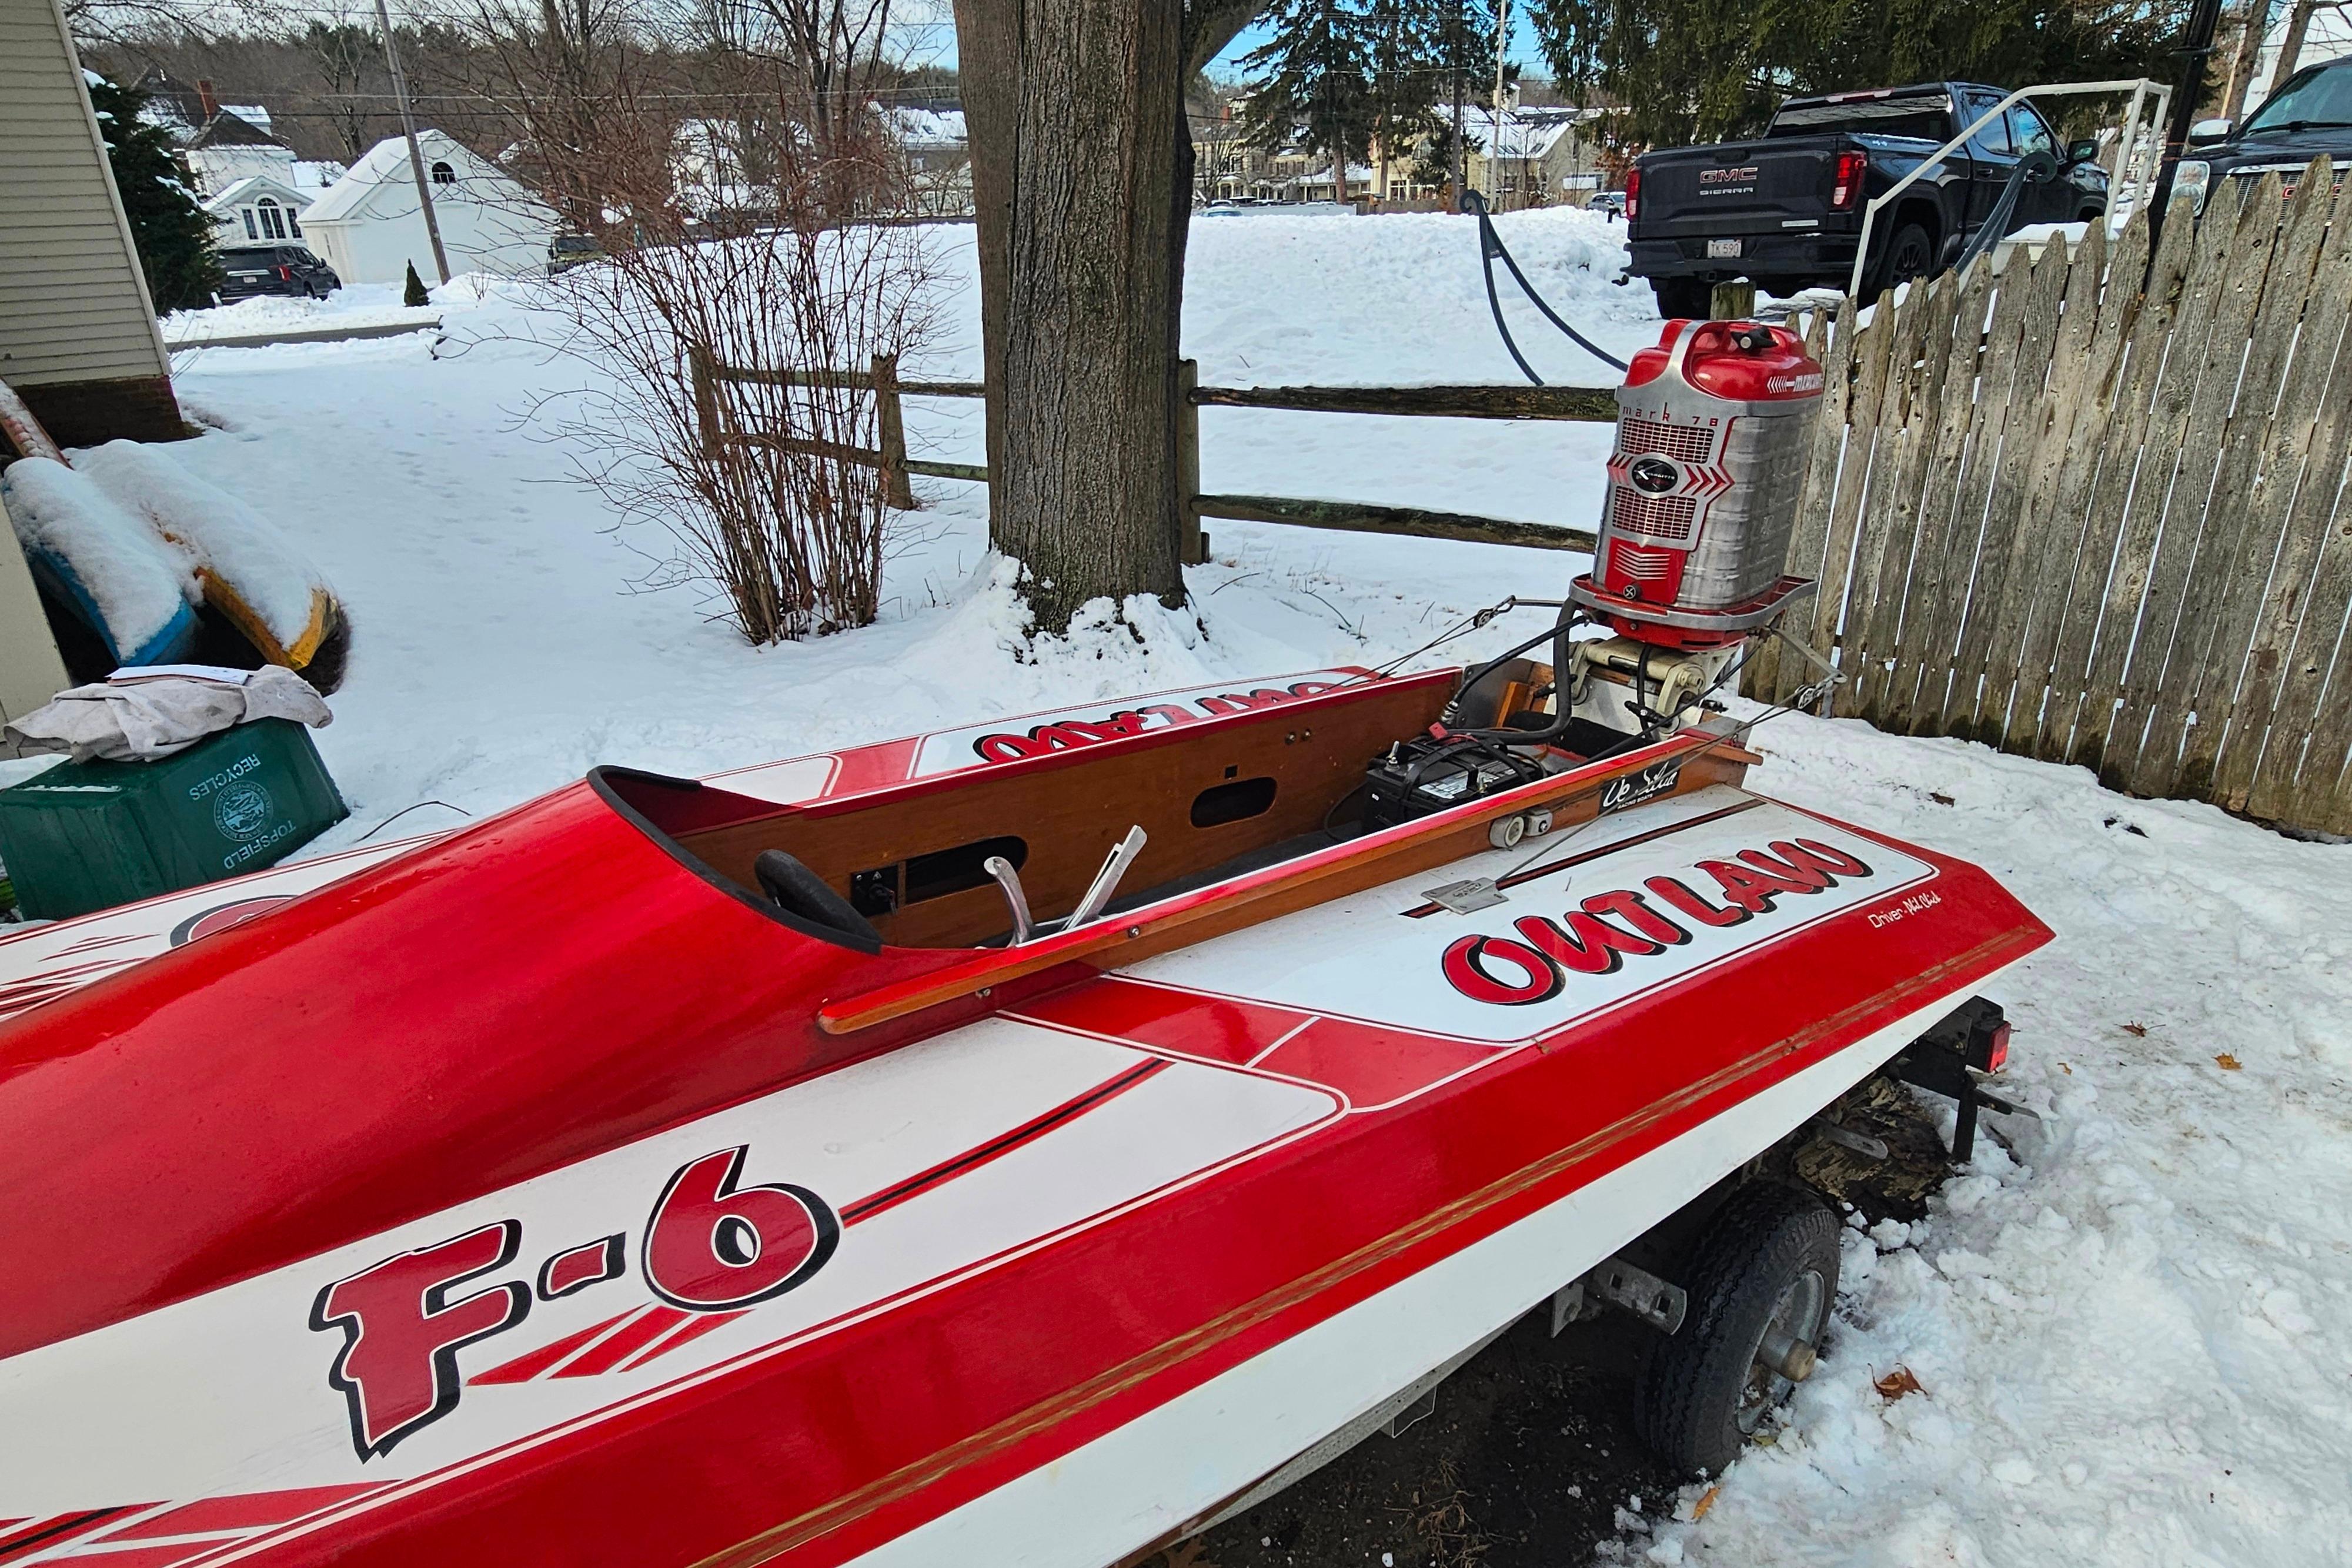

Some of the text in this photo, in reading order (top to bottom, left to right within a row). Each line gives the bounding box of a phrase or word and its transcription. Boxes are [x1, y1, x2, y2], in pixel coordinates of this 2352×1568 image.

[1699, 187, 1753, 195] SIERRA
[1700, 167, 1758, 183] GMC
[1623, 402, 1670, 422] mark
[189, 754, 261, 800] RECYCLES
[223, 820, 296, 870] TOPSFIELD
[1442, 838, 1874, 1006] OUTLAW
[309, 1144, 840, 1465] F-6
